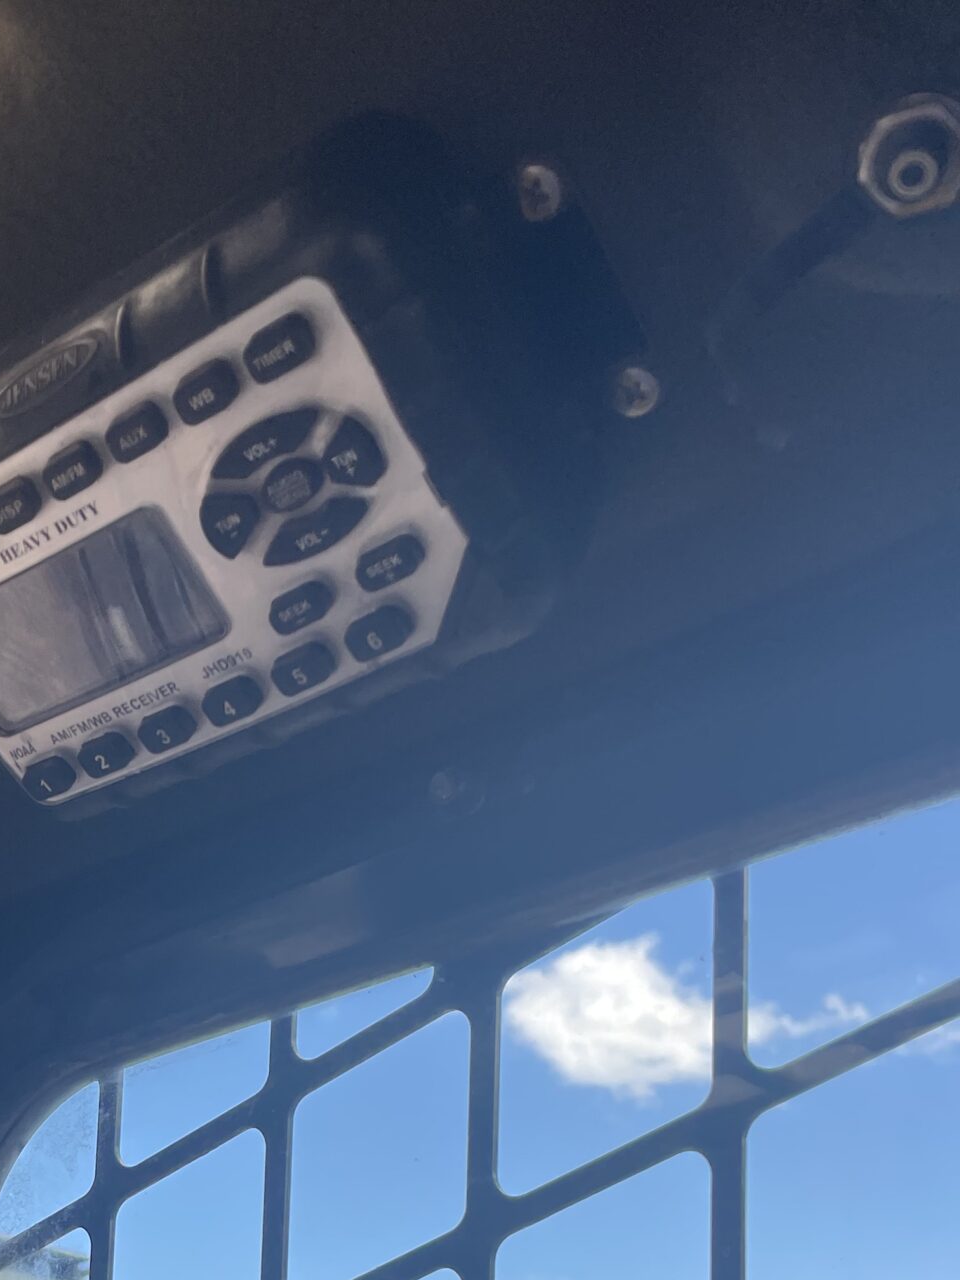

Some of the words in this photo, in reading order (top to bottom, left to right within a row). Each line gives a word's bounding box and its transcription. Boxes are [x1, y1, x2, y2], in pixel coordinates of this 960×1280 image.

[252, 338, 296, 371] TIMER
[1, 348, 82, 406] JENSEN
[189, 387, 215, 410] WB
[119, 424, 148, 450] AUX
[51, 461, 86, 491] AM/FM
[0, 529, 52, 567] HEAVY
[53, 500, 100, 538] DUTY
[367, 632, 382, 649] 6
[292, 667, 306, 685] 5
[49, 710, 113, 745] AM/FM/WB
[112, 681, 180, 719] RECEIVER
[224, 699, 238, 718] 4
[156, 727, 172, 745] 3
[95, 753, 110, 771] 2
[40, 778, 52, 794] 1
